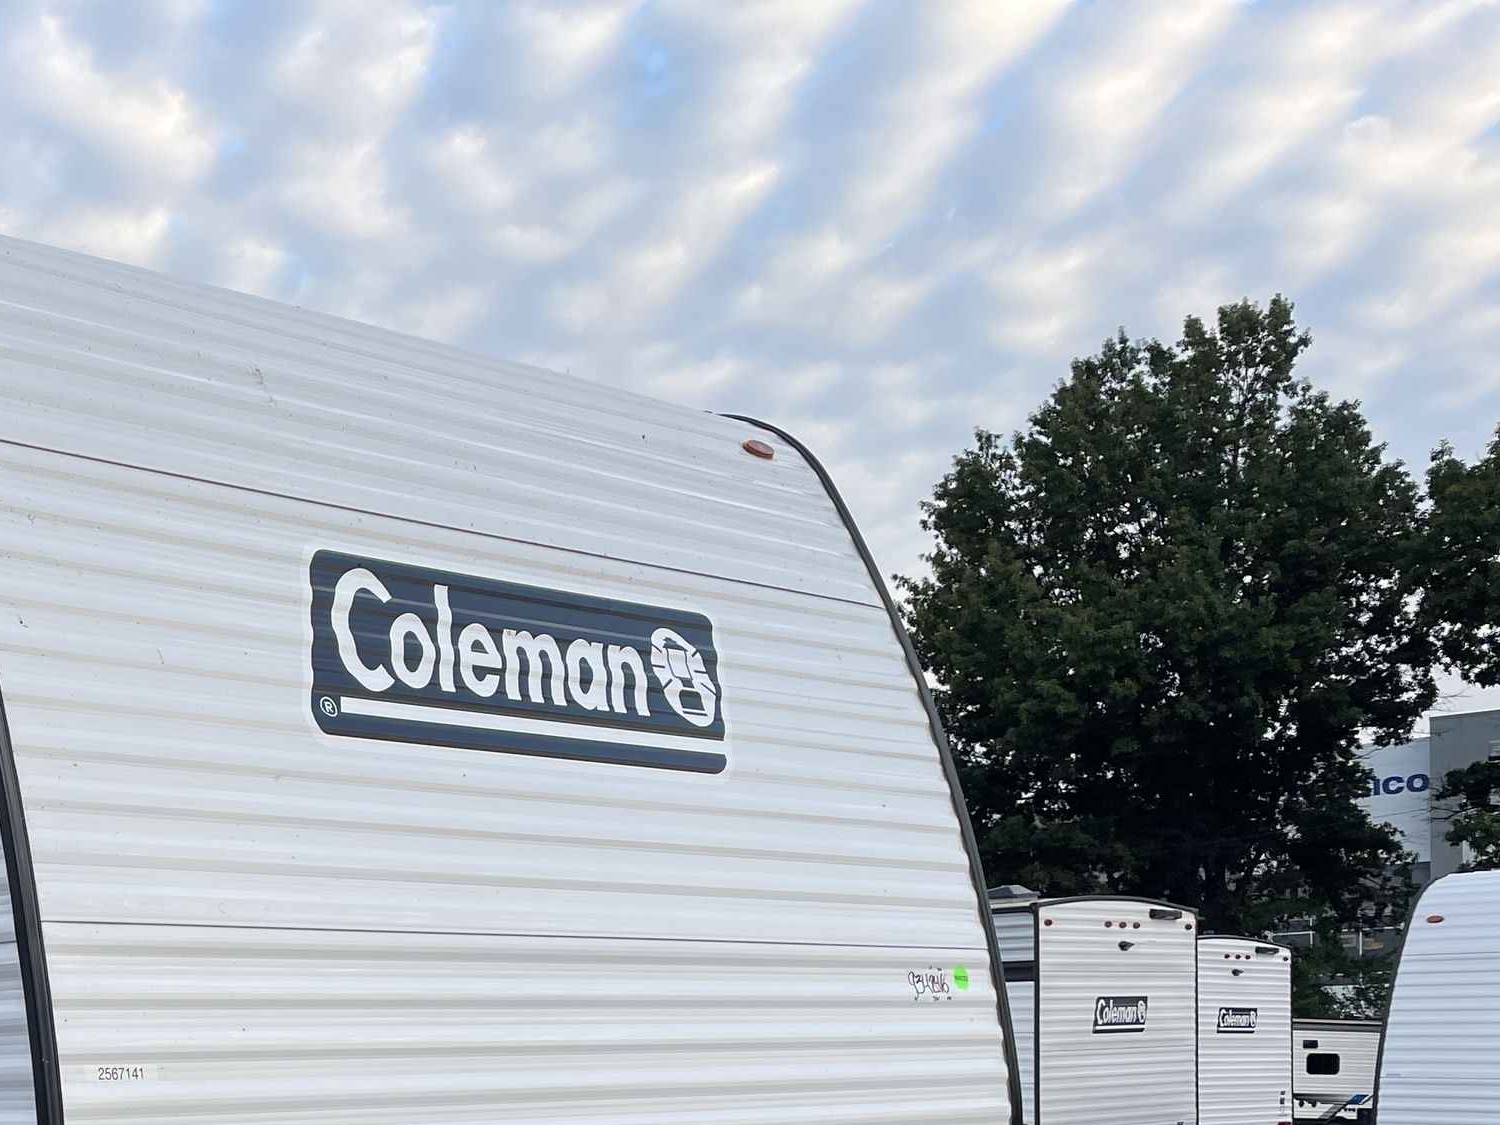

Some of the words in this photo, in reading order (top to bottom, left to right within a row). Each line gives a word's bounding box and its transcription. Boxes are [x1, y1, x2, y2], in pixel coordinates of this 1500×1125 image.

[331, 567, 650, 717] Coleman
[1096, 998, 1137, 1025] Coleman
[1219, 1008, 1251, 1028] Coleman
[97, 1067, 145, 1081] 2567141
